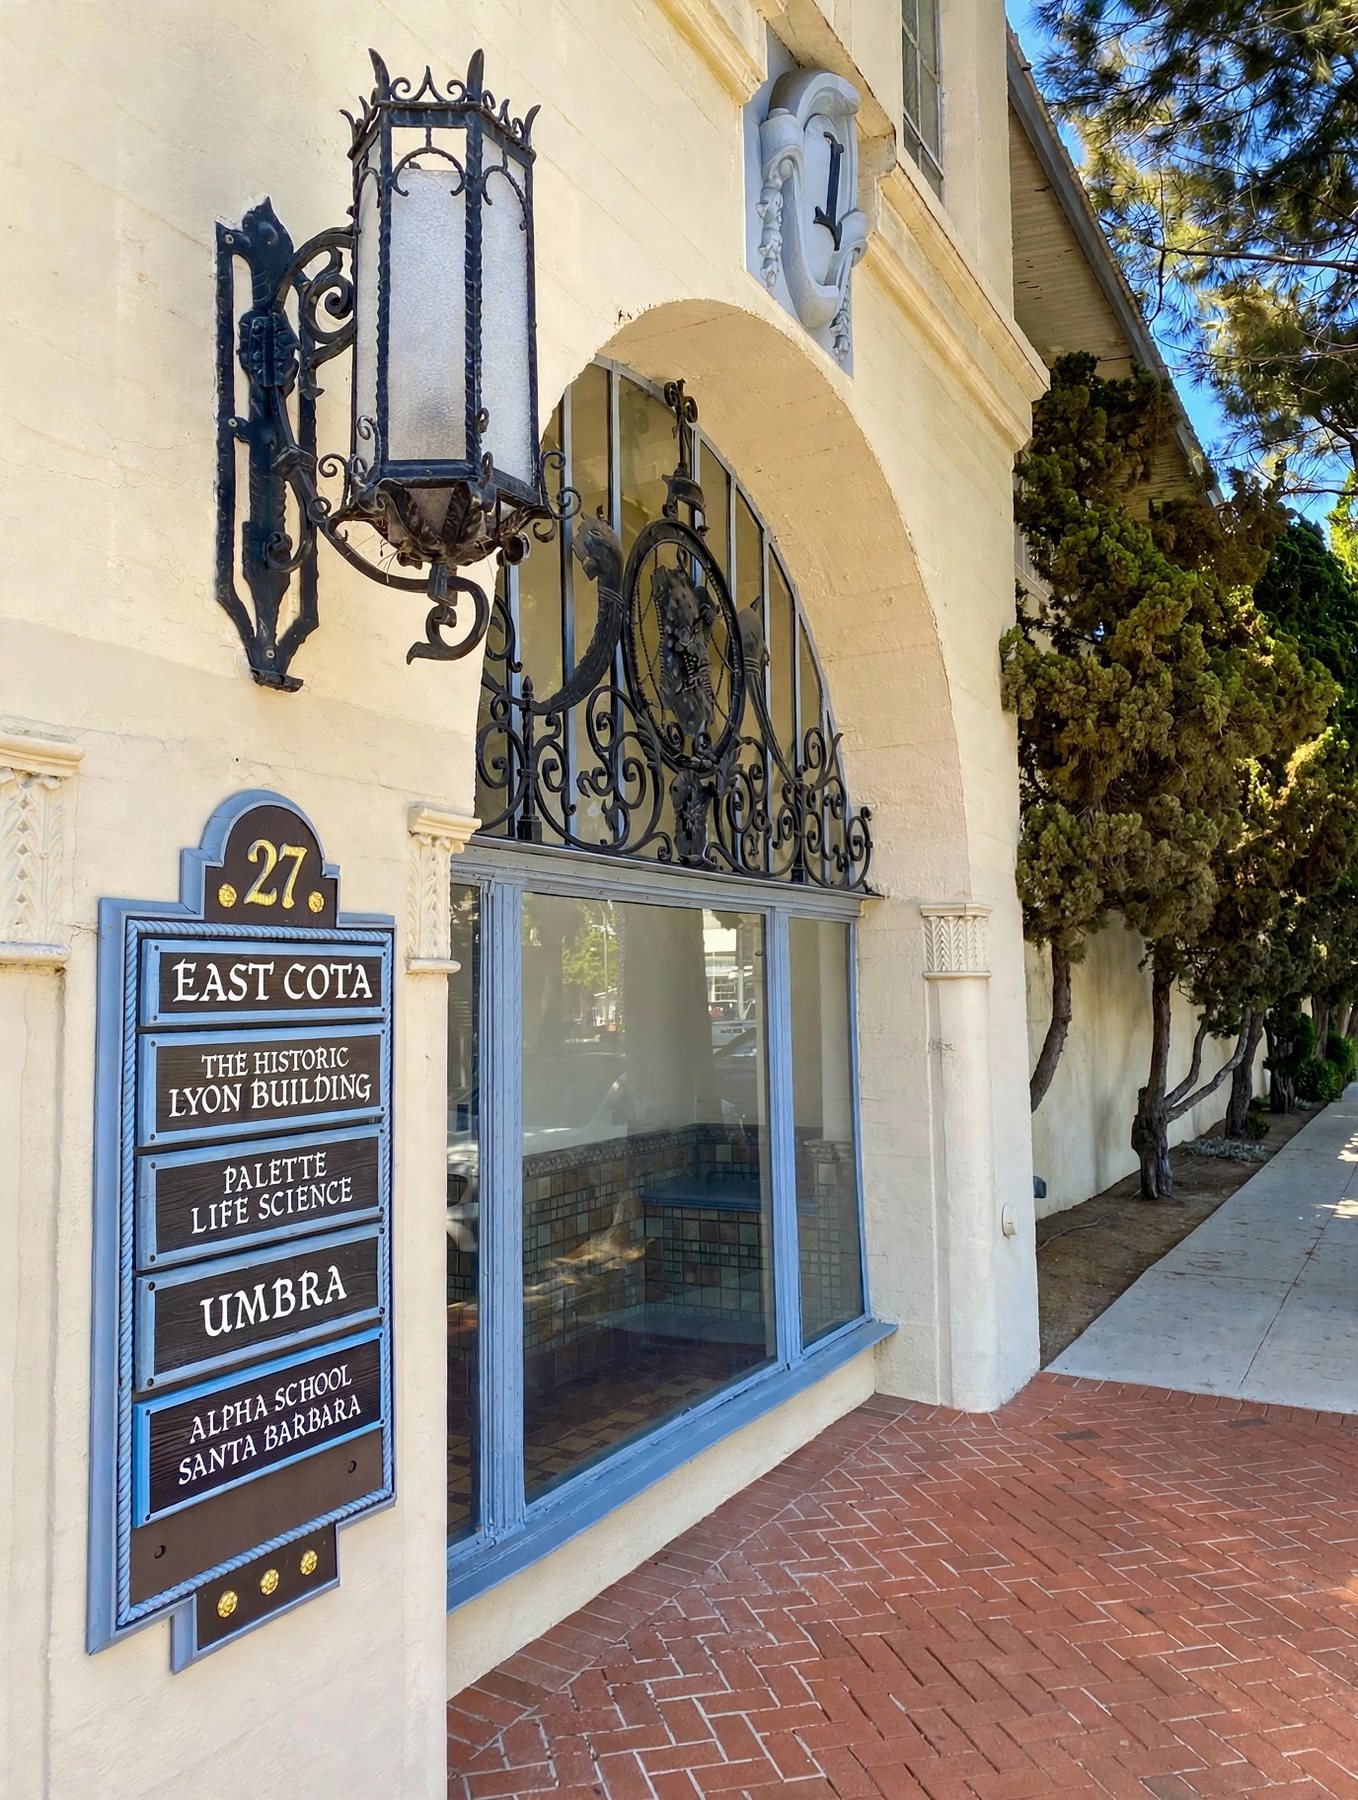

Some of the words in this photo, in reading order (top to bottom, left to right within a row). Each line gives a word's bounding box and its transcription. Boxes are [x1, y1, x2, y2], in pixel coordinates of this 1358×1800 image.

[244, 840, 308, 908] 27
[172, 959, 274, 1002] EAST
[284, 963, 373, 999] COTA
[201, 1051, 248, 1078] THE
[253, 1046, 349, 1073] HISTORIC
[169, 1084, 242, 1117] LYON
[251, 1073, 371, 1108] BUILDING
[223, 1152, 327, 1194] PALETTE
[191, 1197, 249, 1234] LIFE
[259, 1177, 352, 1219] SCIENCE
[200, 1266, 347, 1336] UMBRA
[190, 1397, 268, 1444] ALPHA
[275, 1364, 351, 1411] SCHOOL
[179, 1437, 257, 1484] SANTA
[264, 1394, 360, 1451] BARBARA
